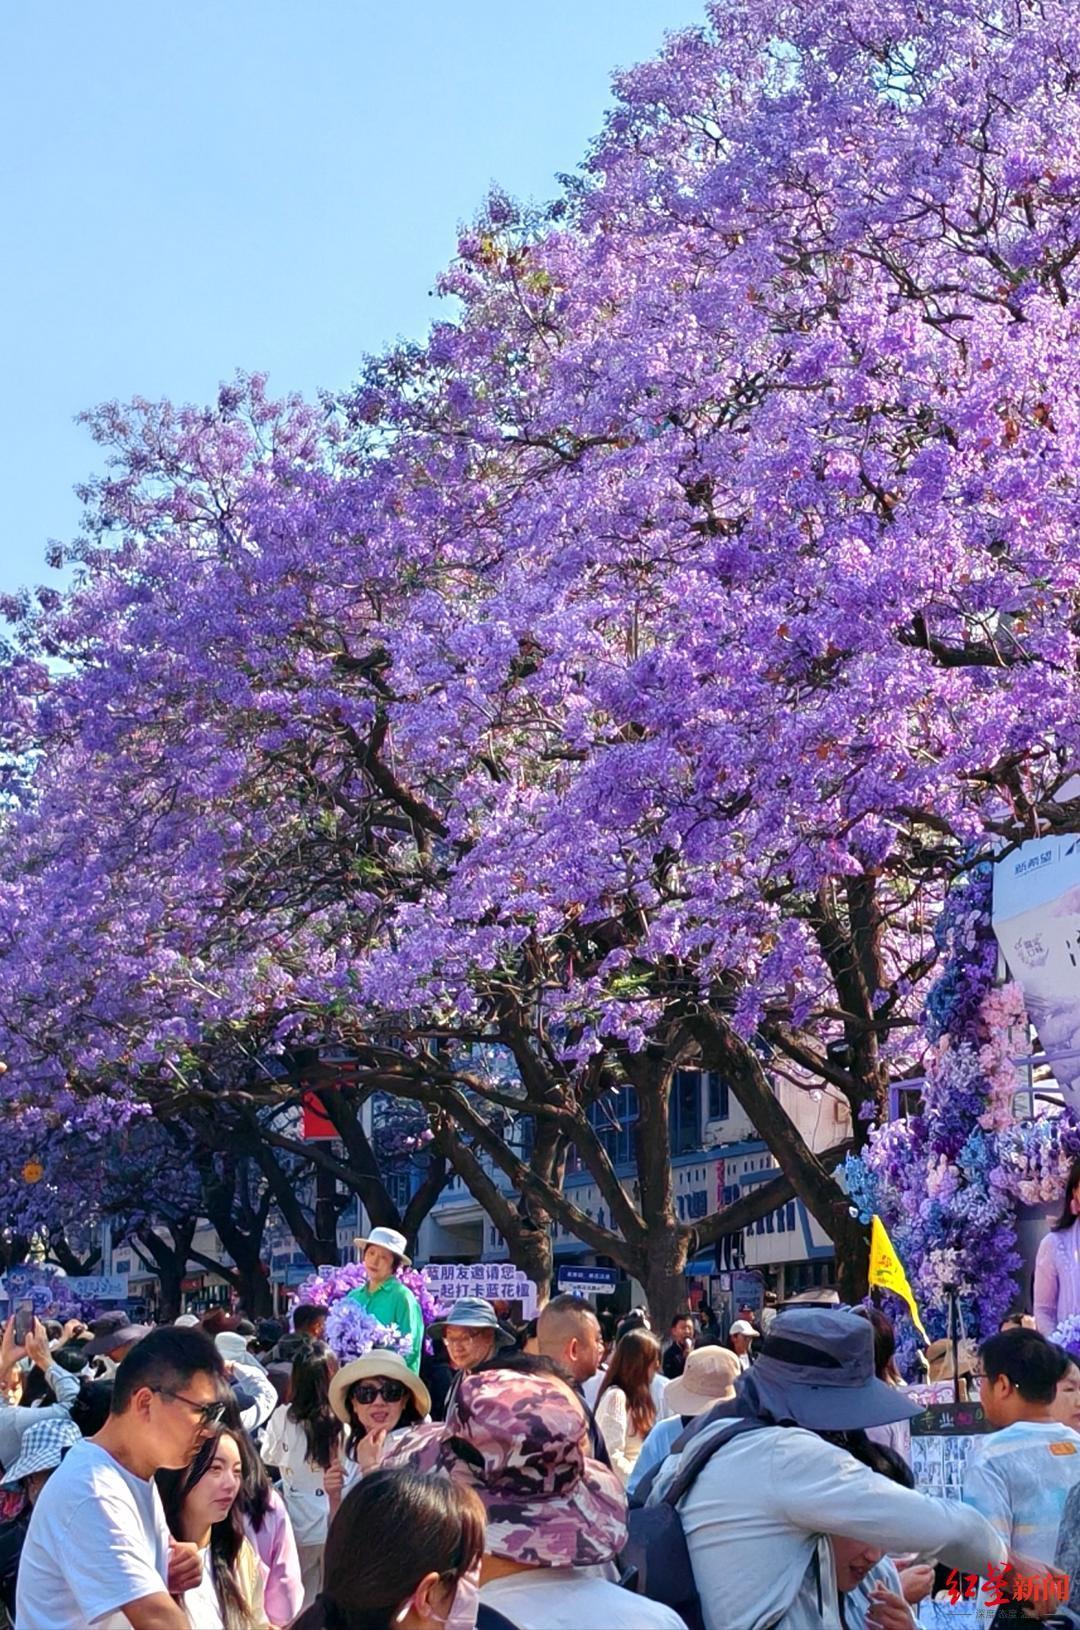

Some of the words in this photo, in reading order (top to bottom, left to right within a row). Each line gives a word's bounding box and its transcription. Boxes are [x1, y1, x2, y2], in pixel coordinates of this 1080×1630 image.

[426, 1266, 515, 1280] 蓝朋友邀请您
